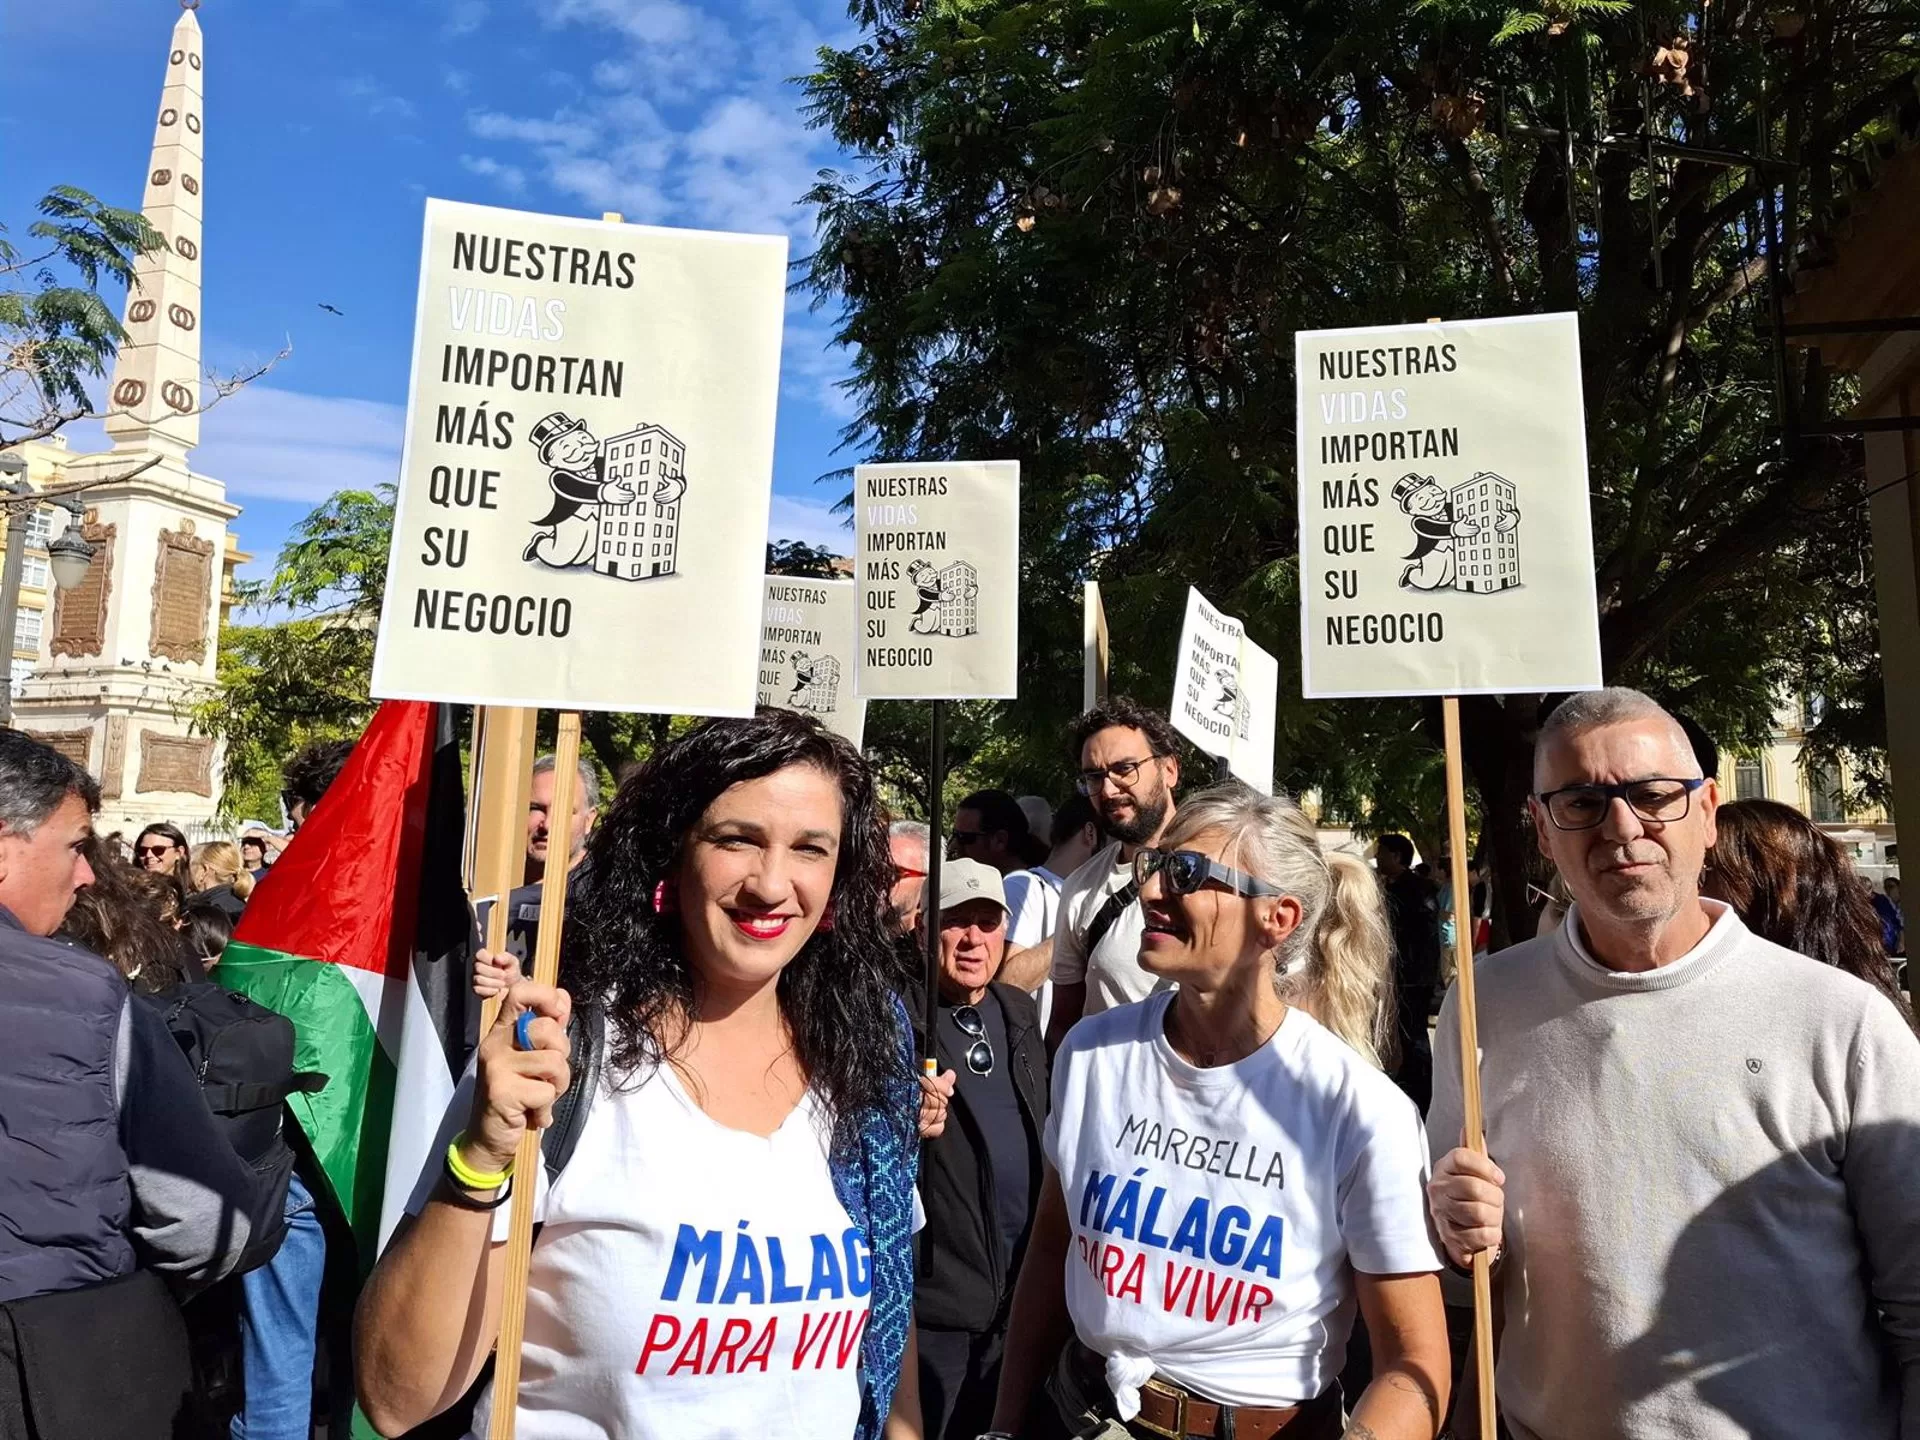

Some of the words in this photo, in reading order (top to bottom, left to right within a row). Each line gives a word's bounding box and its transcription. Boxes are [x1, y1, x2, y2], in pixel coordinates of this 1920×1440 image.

[453, 232, 636, 288] NUESTRAS
[448, 286, 566, 342] VIDAS
[442, 345, 623, 398] IMPORTAN
[1319, 344, 1457, 380] NUESTRAS
[1321, 388, 1408, 425] VIDAS
[436, 401, 514, 450] MÁS
[1321, 428, 1459, 464] IMPORTAN
[429, 465, 500, 510] QUE
[867, 476, 947, 497] NUESTRAS
[1323, 473, 1379, 509] MÁS
[868, 504, 917, 526] VIDAS
[421, 527, 468, 568] SU
[867, 532, 946, 551] IMPORTAN
[1324, 524, 1375, 556] QUE
[867, 558, 899, 580] MÁS
[1325, 570, 1357, 600] SU
[414, 588, 572, 638] NEGOCIO
[769, 586, 826, 604] NUESTRAS
[867, 591, 896, 610] QUE
[767, 606, 803, 626] VIDAS
[867, 620, 886, 638] SU
[1198, 603, 1243, 644] NUESTRA
[1327, 612, 1443, 646] NEGOCIO
[764, 627, 821, 645] IMPORTAN
[762, 647, 785, 664] MÁS
[867, 648, 933, 667] NEGOCIO
[760, 670, 780, 686] QUE
[1187, 683, 1200, 702] SU
[1190, 666, 1207, 691] QUE
[1184, 701, 1231, 737] NEGOCIO
[1115, 1113, 1285, 1190] MARBELLA
[1079, 1167, 1283, 1280] MÁLAGA
[660, 1219, 872, 1304] MÁLAG
[1163, 1261, 1274, 1326] VIVIR
[635, 1314, 778, 1375] PARA
[792, 1309, 870, 1371] VIV
